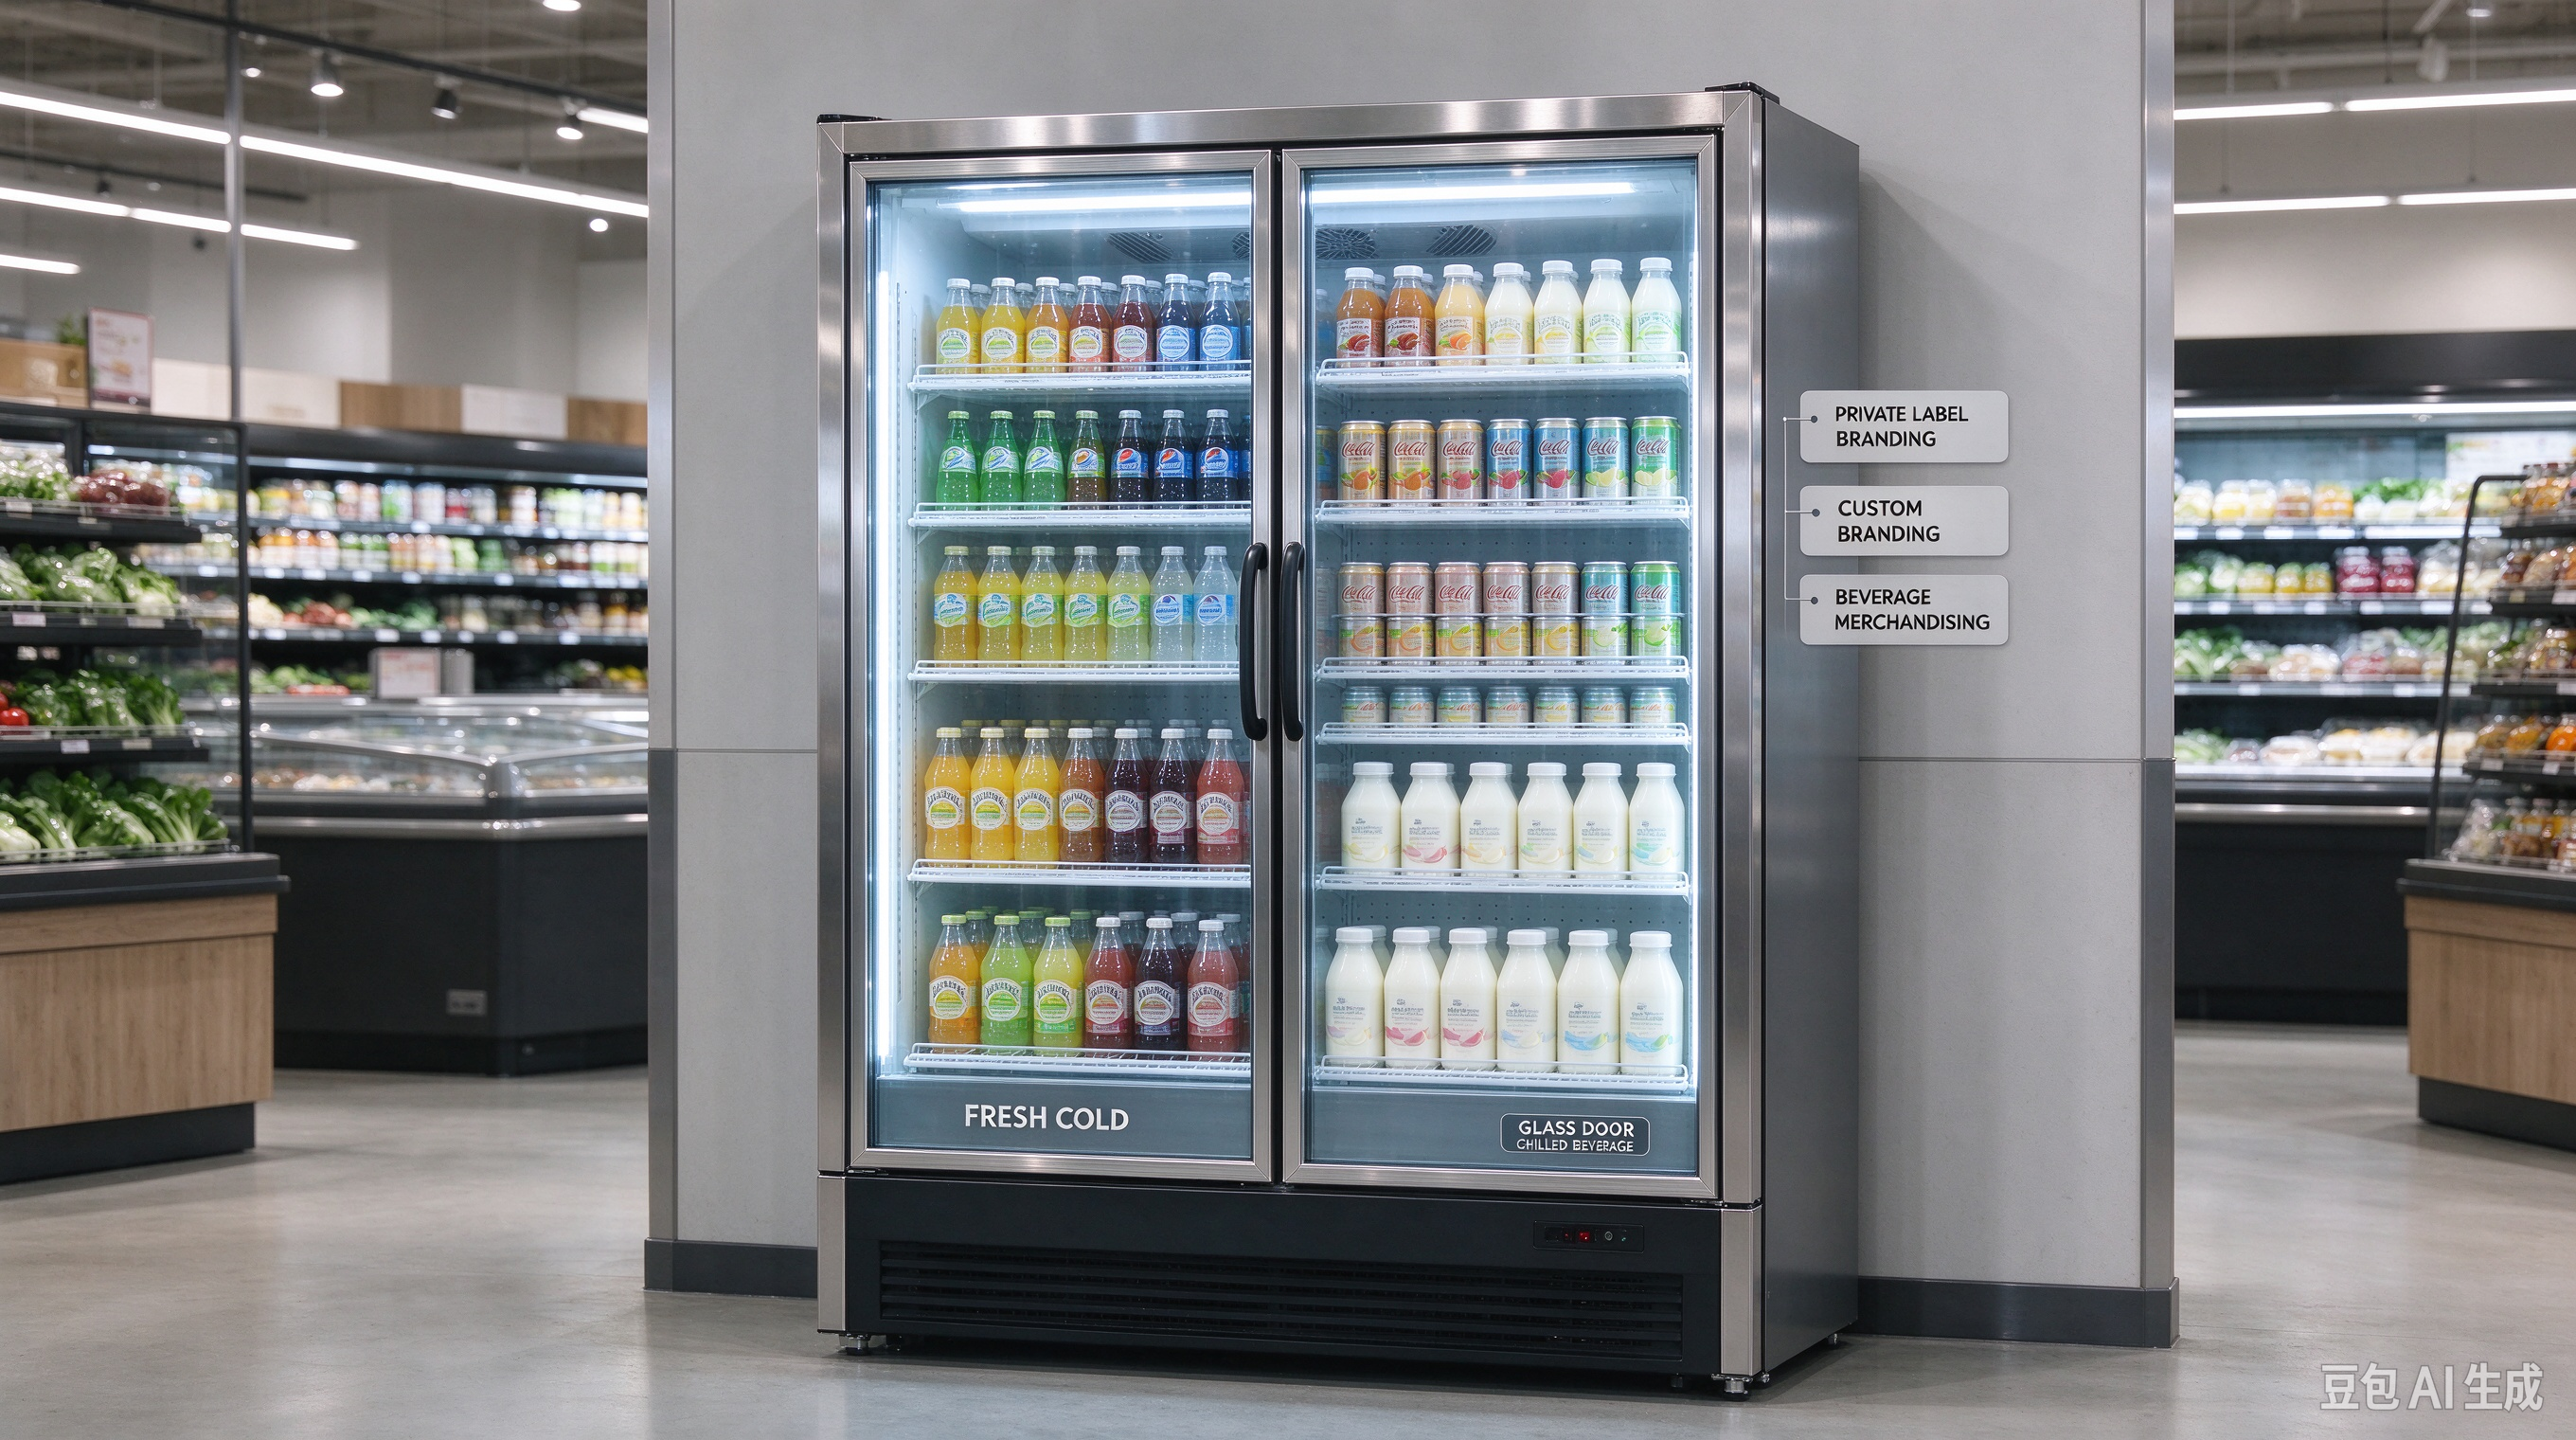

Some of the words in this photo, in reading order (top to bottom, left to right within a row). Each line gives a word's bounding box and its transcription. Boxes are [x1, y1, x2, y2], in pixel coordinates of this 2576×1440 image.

[964, 1104, 1047, 1129] FRESH
[1055, 1107, 1130, 1131] COLD
[1518, 1120, 1576, 1136] GLASS
[1582, 1121, 1635, 1137] DOOR
[1516, 1138, 1567, 1151] CHILLED
